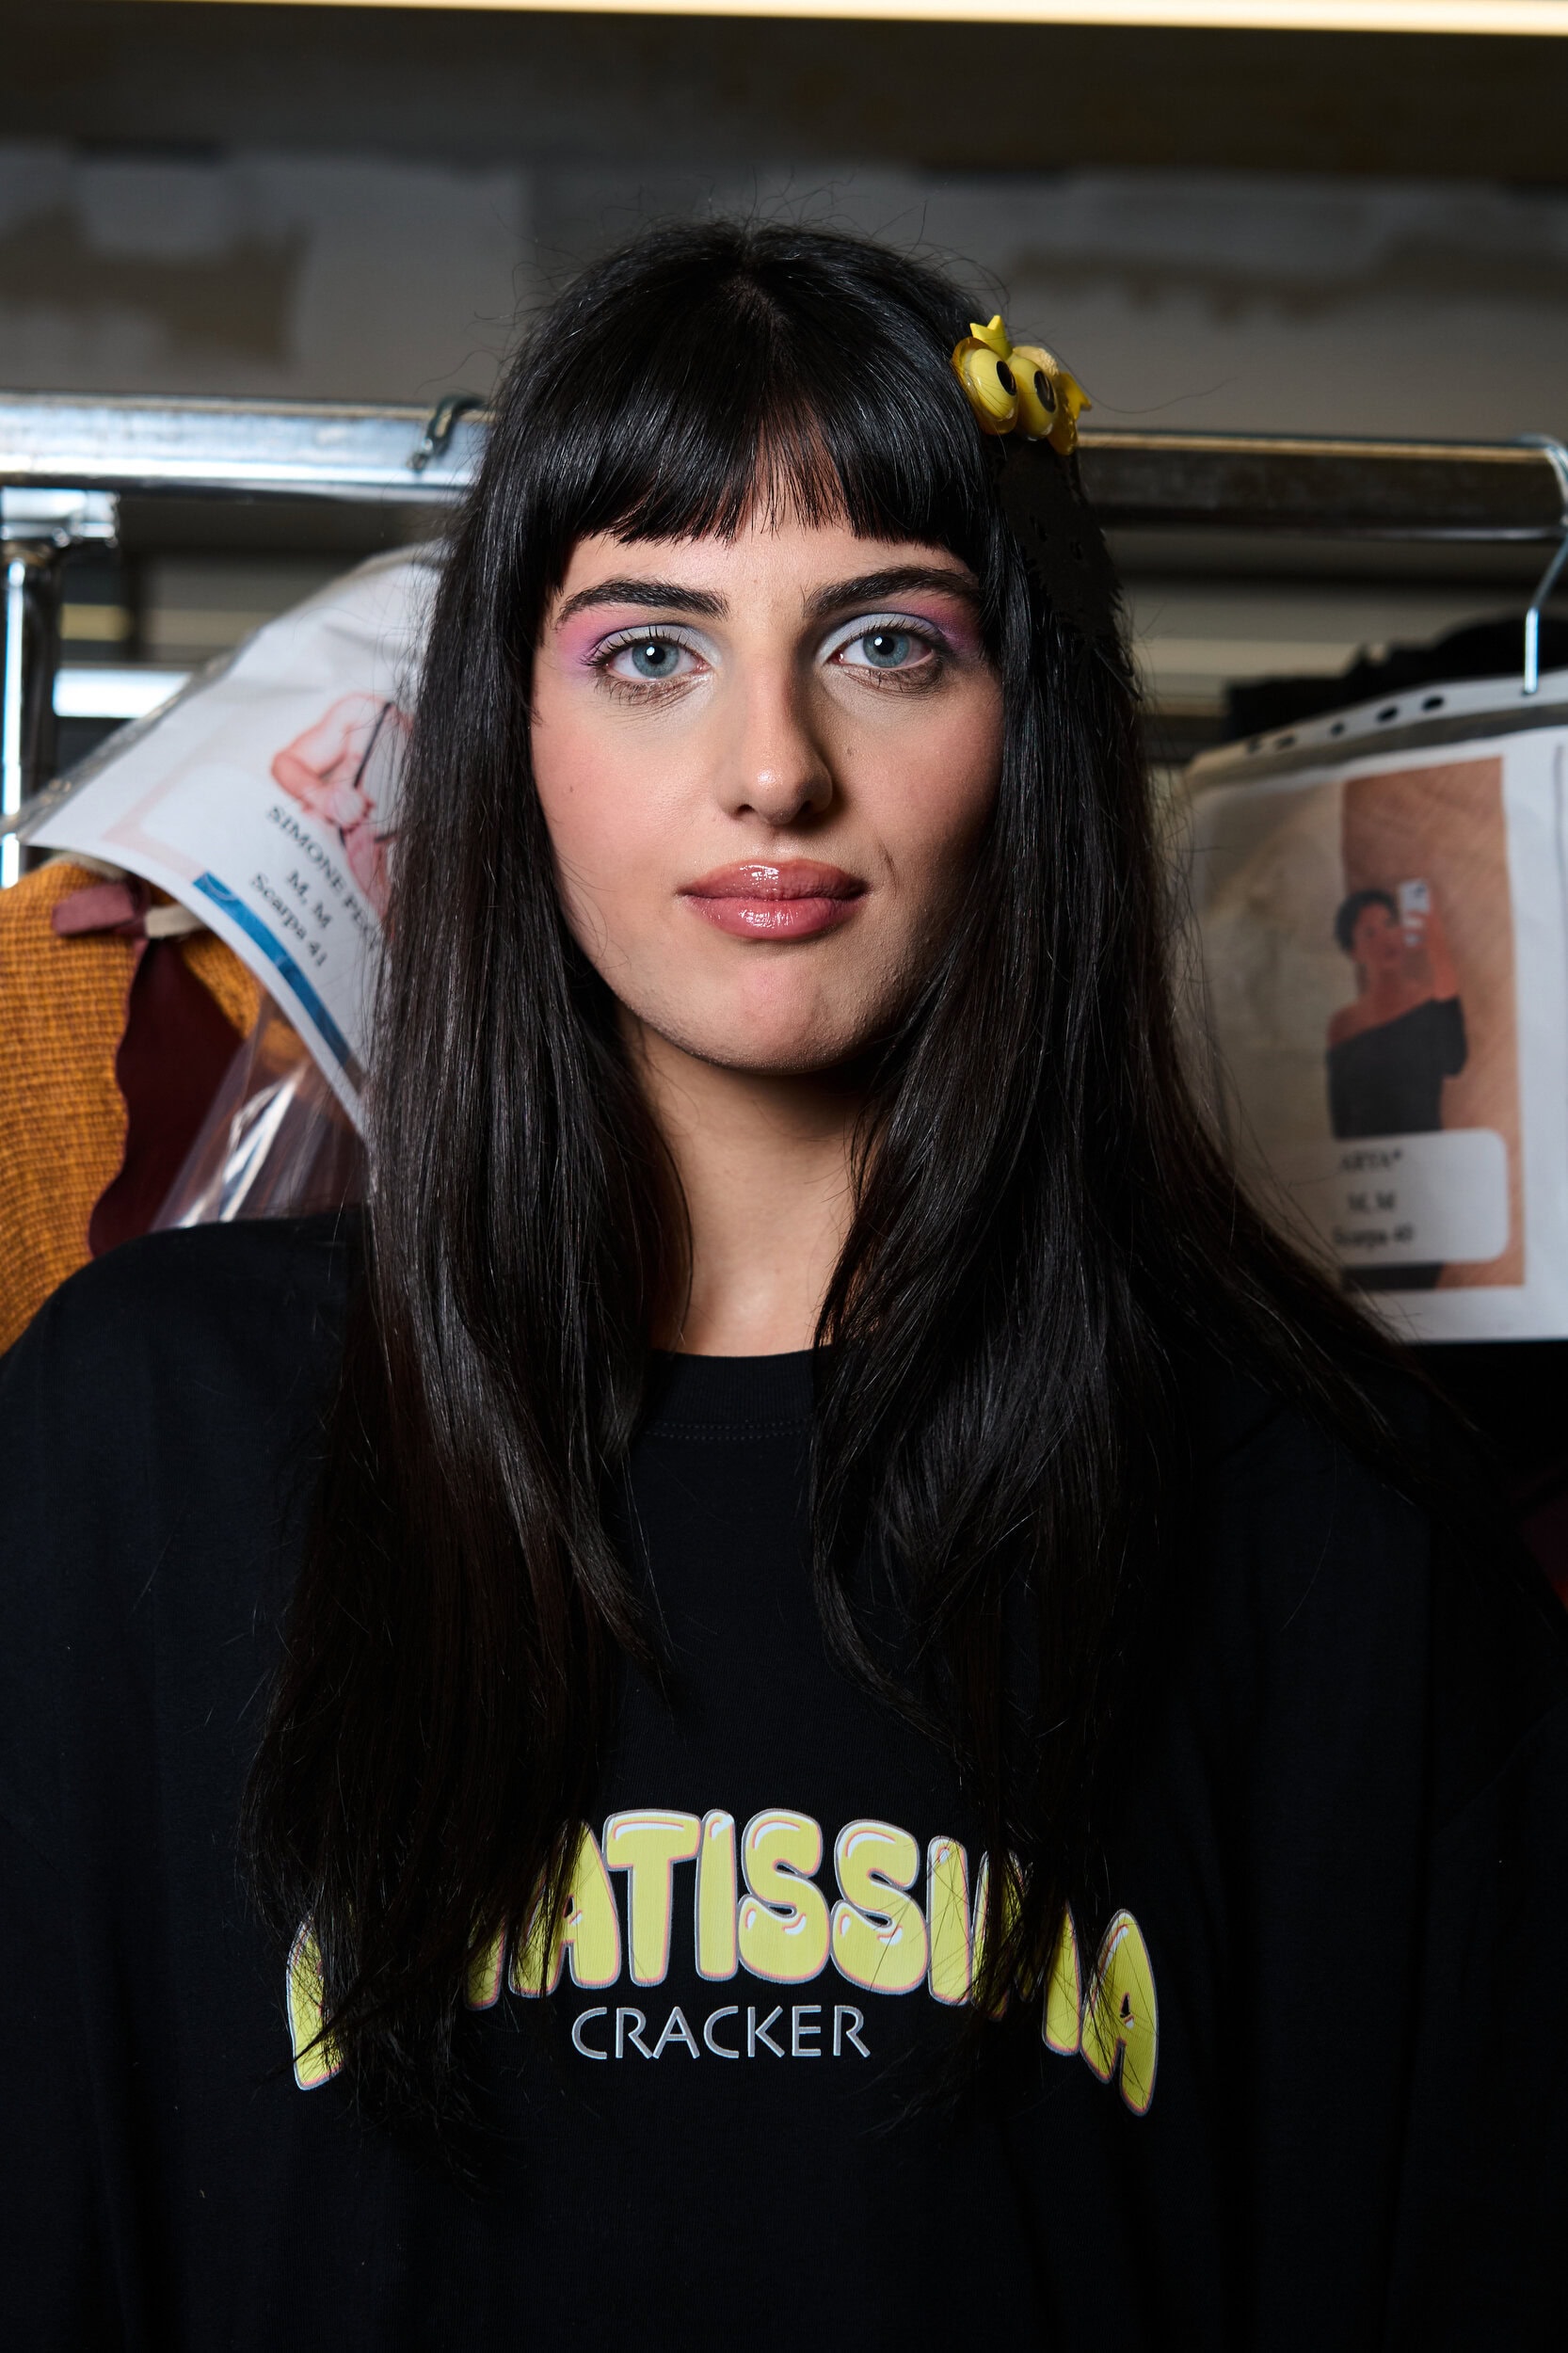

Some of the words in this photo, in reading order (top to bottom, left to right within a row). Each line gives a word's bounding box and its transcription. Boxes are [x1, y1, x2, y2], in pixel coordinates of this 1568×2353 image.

[267, 805, 347, 893] SIMONE
[249, 872, 307, 940] Scarpa
[312, 901, 333, 929] M
[571, 2004, 872, 2060] CRACKER
